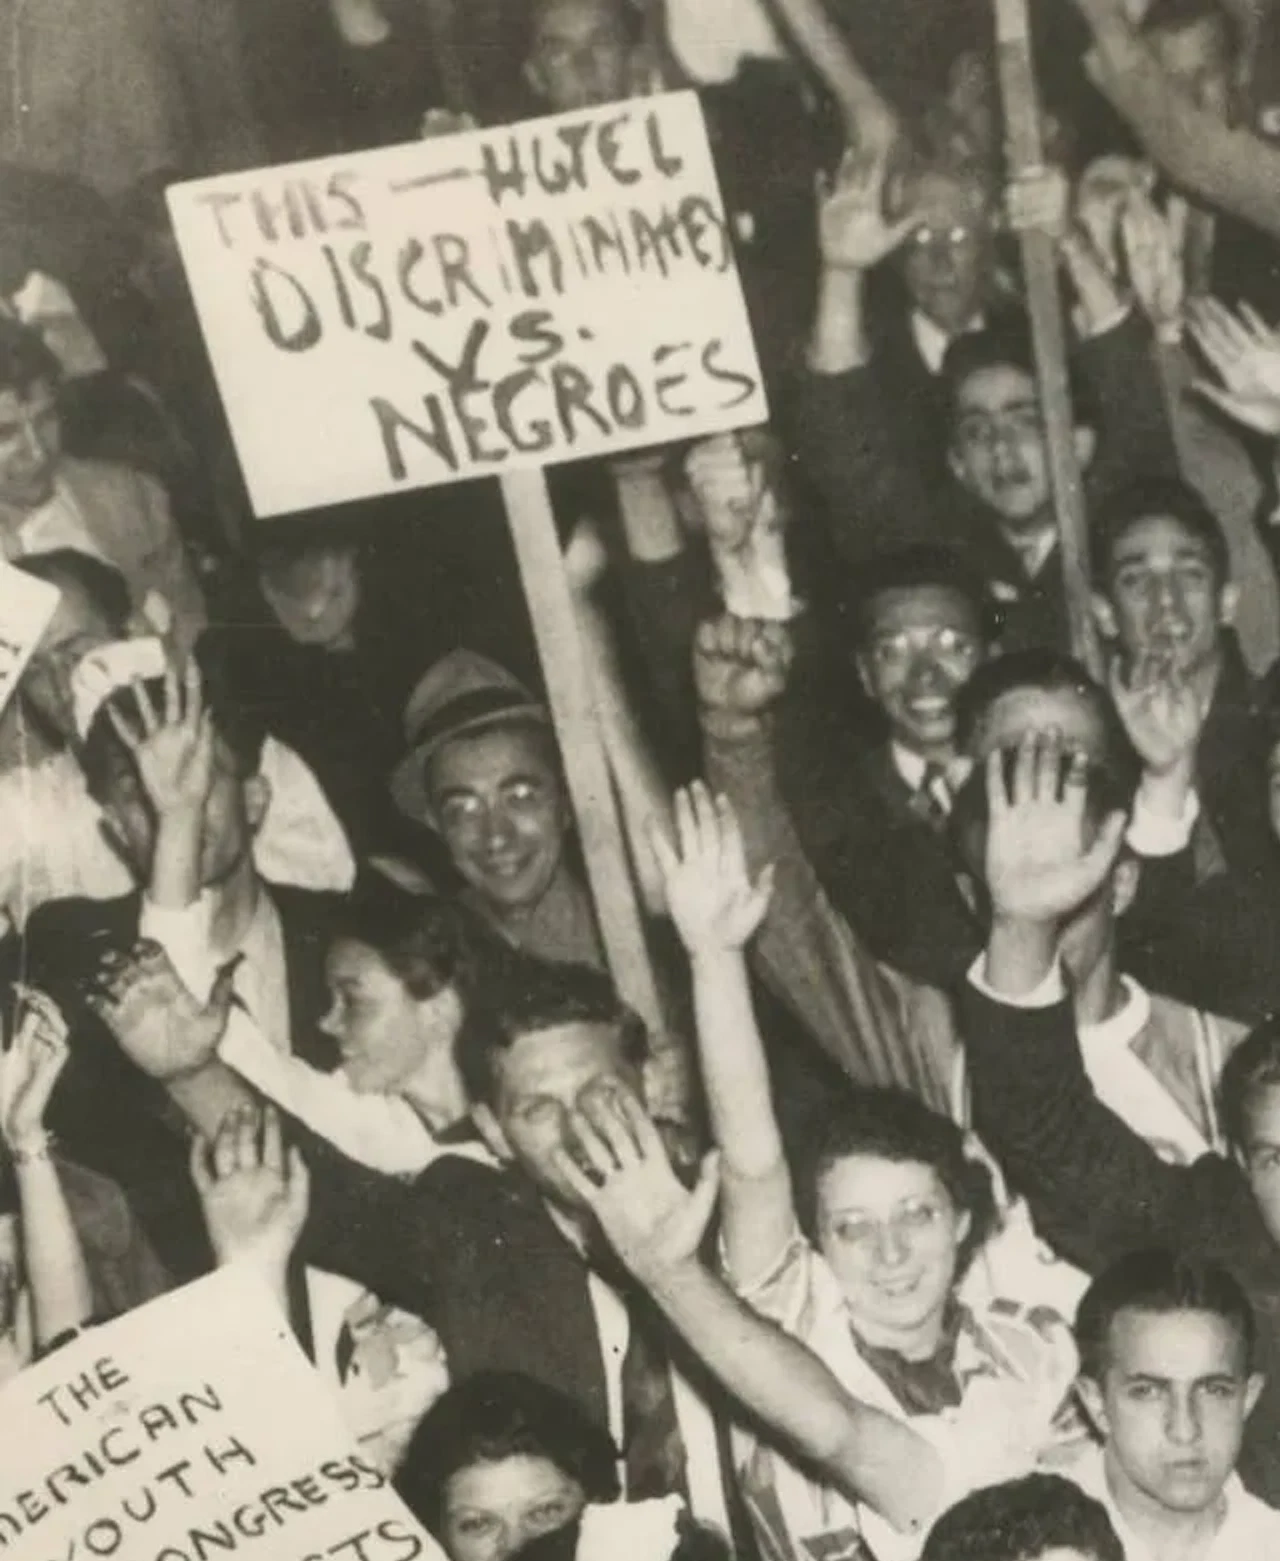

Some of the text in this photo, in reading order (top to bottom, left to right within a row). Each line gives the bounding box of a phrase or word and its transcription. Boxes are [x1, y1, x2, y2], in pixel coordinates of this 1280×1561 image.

[194, 168, 368, 248] THIS
[367, 337, 757, 481] NEGROES
[37, 1356, 130, 1426] THE
[0, 1383, 224, 1547] MERICAN
